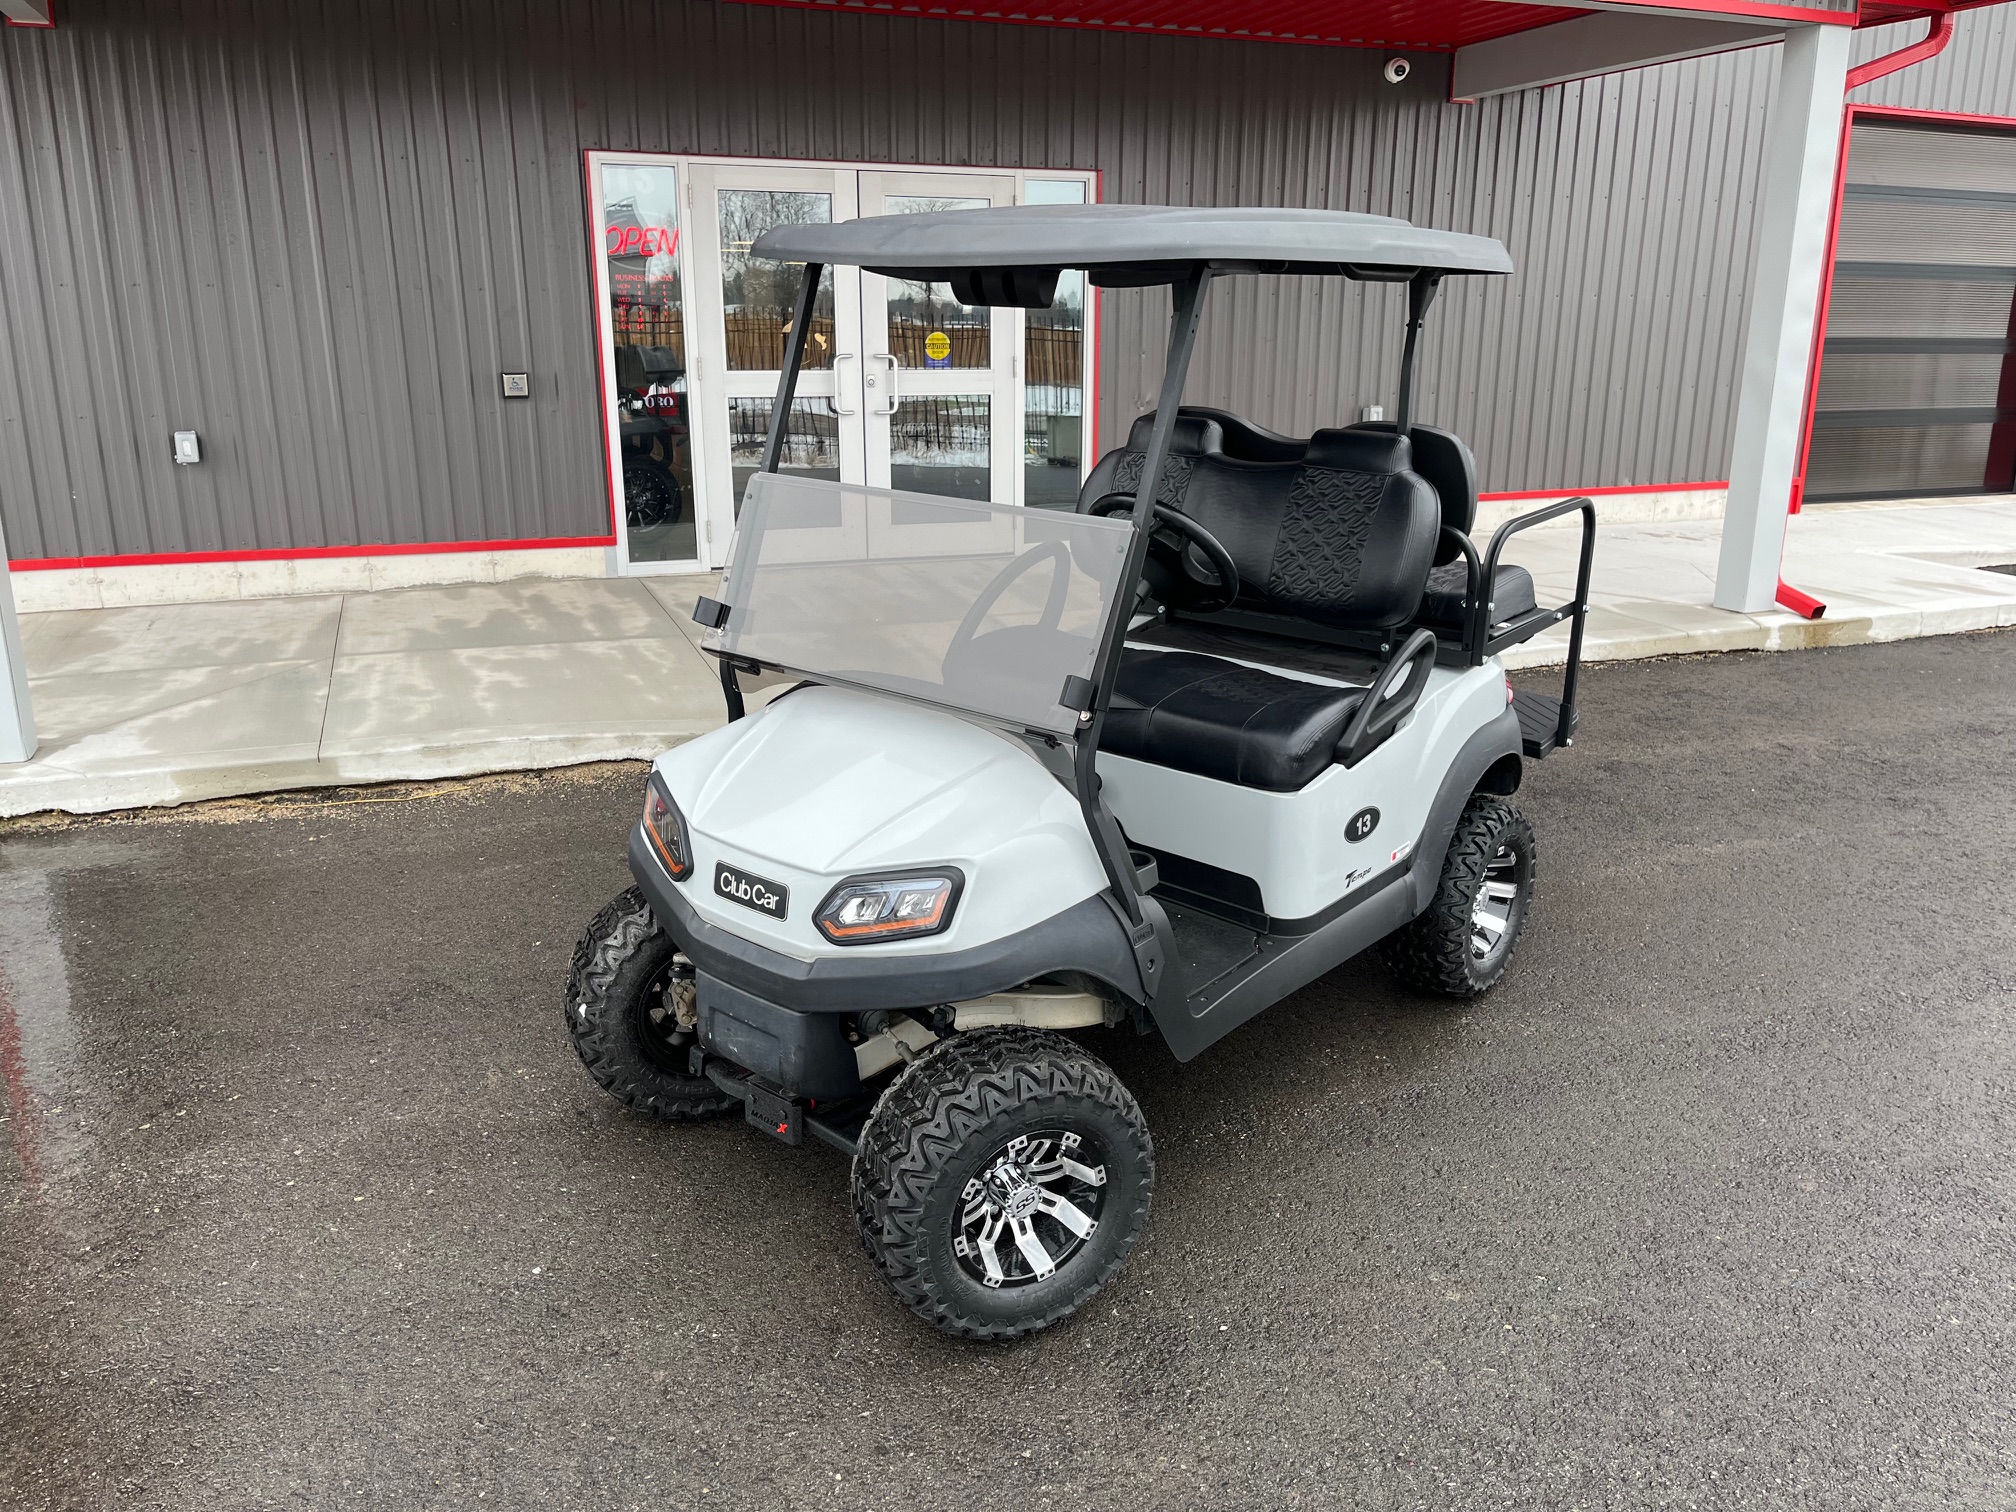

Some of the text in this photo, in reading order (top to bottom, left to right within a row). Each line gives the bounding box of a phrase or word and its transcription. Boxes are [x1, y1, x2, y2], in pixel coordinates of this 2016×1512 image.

[606, 226, 679, 257] OPEN
[615, 274, 646, 282] BUSINESS
[1356, 814, 1372, 836] 13
[1345, 866, 1372, 889] Tempo
[720, 871, 780, 910] Club Car
